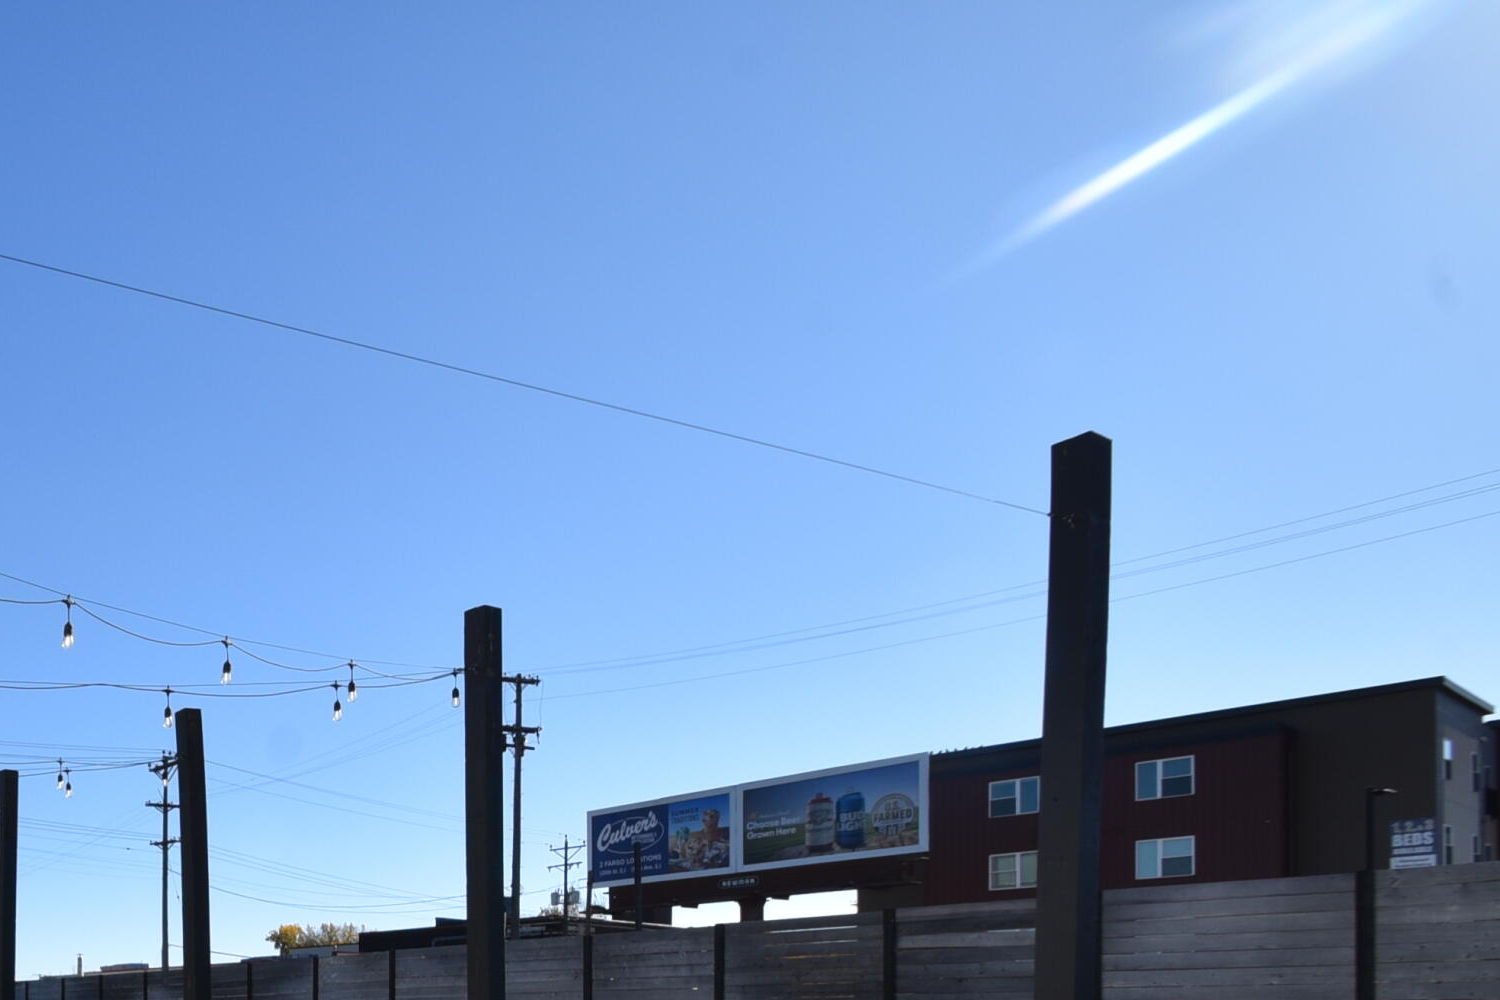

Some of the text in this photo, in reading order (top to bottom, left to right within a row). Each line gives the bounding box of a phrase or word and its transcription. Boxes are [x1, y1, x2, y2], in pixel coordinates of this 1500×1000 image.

[840, 811, 863, 822] BUD
[874, 809, 913, 822] FARMED
[746, 818, 780, 830] Choose
[596, 810, 658, 853] Culver's
[746, 826, 797, 840] Grown Here
[1392, 831, 1434, 847] BEDS
